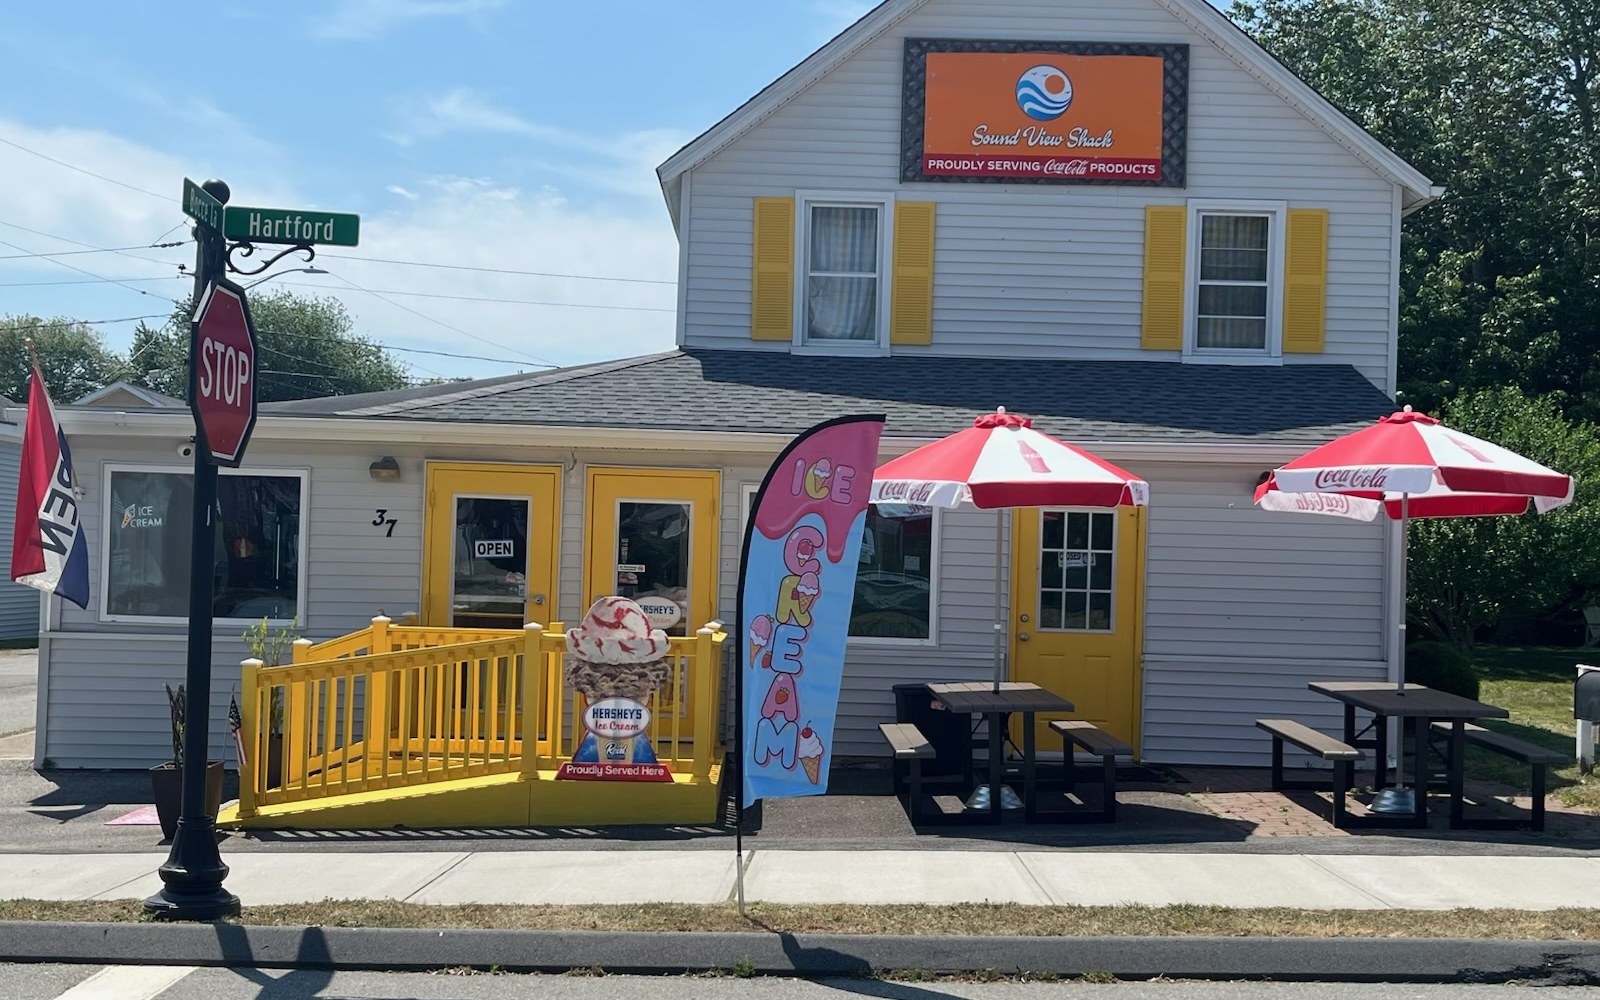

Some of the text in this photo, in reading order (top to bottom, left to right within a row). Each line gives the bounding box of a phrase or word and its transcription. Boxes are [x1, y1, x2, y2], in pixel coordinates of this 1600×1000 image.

[971, 124, 1114, 148] Sound View Shack
[928, 159, 985, 171] PROUDLY
[987, 161, 1041, 172] SERVING
[1090, 163, 1156, 175] PRODUCTS
[250, 212, 334, 241] Hartford
[200, 337, 250, 407] STOP
[791, 457, 855, 505] ICE
[138, 505, 153, 517] ICE
[130, 517, 163, 528] CREAM
[372, 509, 398, 538] 37
[477, 542, 512, 556] OPEN
[753, 525, 824, 770] CREAM
[592, 708, 642, 720] HERSHEY'S
[595, 720, 640, 731] Ice Cream
[566, 765, 665, 777] Proudly Served Here
